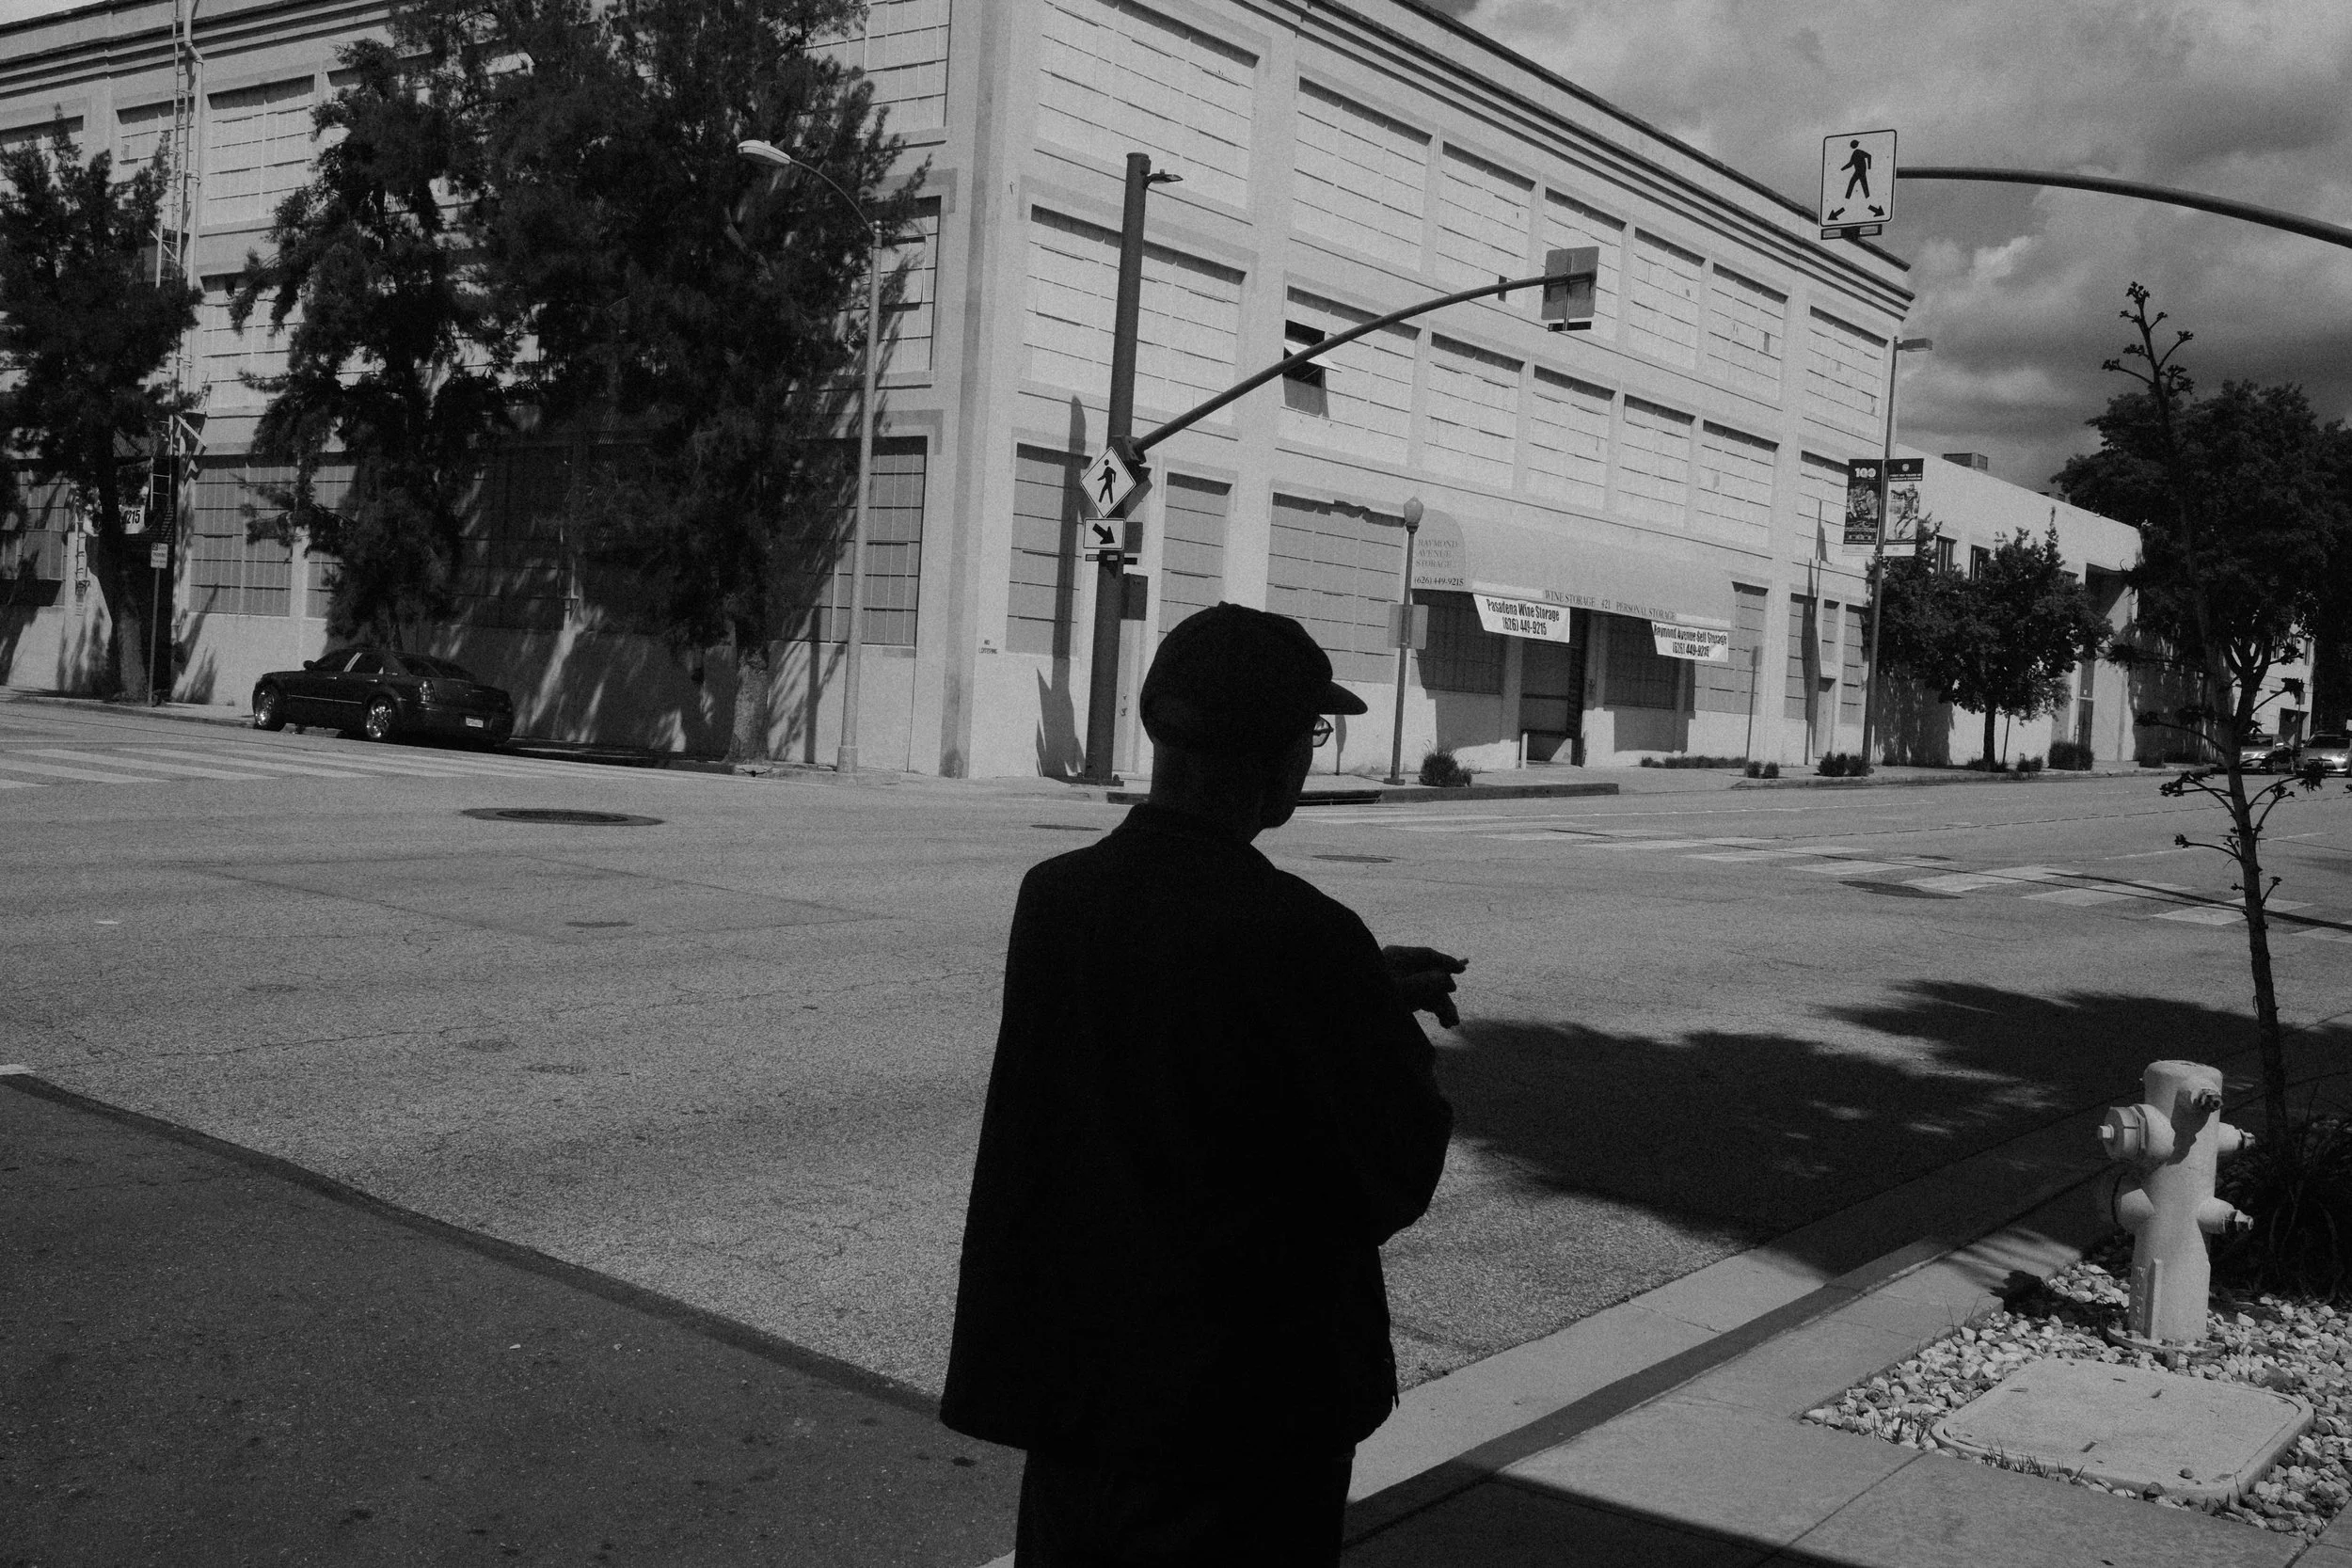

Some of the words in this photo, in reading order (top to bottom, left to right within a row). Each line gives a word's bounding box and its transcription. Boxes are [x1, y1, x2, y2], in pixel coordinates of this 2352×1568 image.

[1854, 467, 1876, 478] 100
[1418, 539, 1458, 548] RAYMOND
[1414, 576, 1432, 585] (626)
[1434, 578, 1464, 587] 449-9215
[1486, 598, 1518, 615] Pasadena
[1518, 603, 1534, 617] Wine
[1535, 605, 1560, 622] Storage
[1545, 590, 1564, 603] WINE
[1565, 594, 1595, 608] STORAGE
[1616, 601, 1646, 616] PERSONAL
[1648, 608, 1677, 621] STORAGE
[1502, 616, 1519, 631] (626)
[1520, 619, 1547, 635] 449-9215
